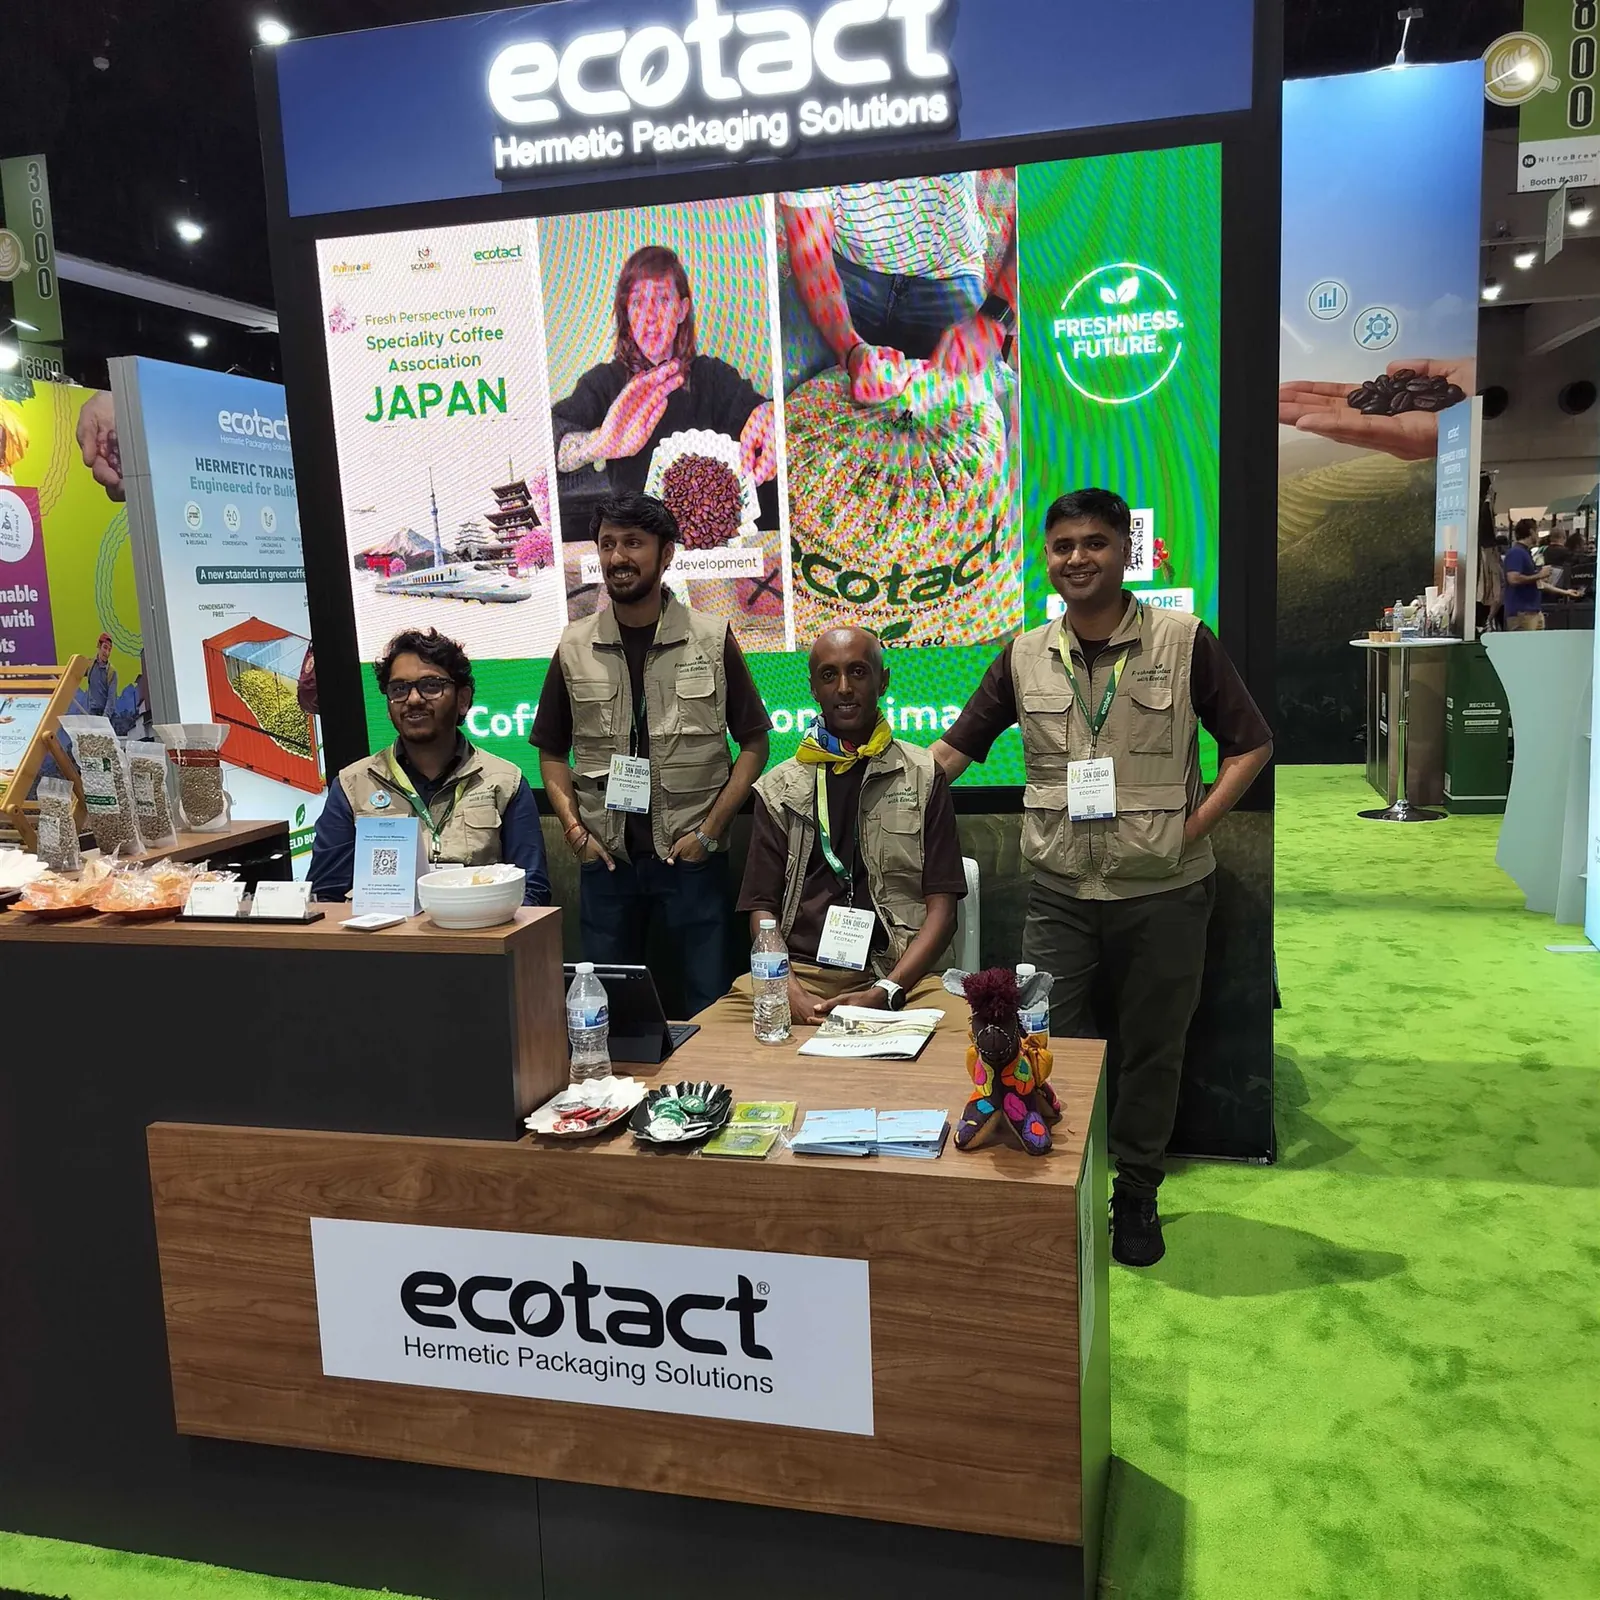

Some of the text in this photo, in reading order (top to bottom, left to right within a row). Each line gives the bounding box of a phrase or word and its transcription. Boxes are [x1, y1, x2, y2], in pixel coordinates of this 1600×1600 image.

[488, 0, 950, 123] ecotact
[494, 91, 948, 168] Hermetic Packaging Solutions
[1530, 177, 1556, 186] Booth
[1568, 174, 1588, 183] 3817
[27, 161, 53, 299] 3600
[474, 245, 522, 260] ecotact
[365, 306, 496, 326] Fresh Perspective from
[1053, 310, 1184, 338] FRESHNESS.
[366, 328, 504, 352] Speciality Coffee
[1073, 334, 1163, 359] FUTURE.
[388, 354, 482, 372] Association
[365, 377, 507, 422] JAPAN
[218, 408, 291, 440] ecotact
[220, 435, 244, 446] Hermetic
[246, 438, 271, 451] Packaging
[195, 457, 256, 476] HERMETIC
[190, 476, 296, 498] Engineered for Bulk
[675, 558, 757, 571] development
[791, 514, 1002, 605] cotact
[200, 569, 207, 580] A
[208, 571, 225, 580] new
[225, 569, 259, 580] standard
[260, 569, 268, 578] in
[268, 570, 288, 581] green
[814, 598, 850, 614] GREEN
[855, 608, 897, 617] COFFEE
[901, 601, 950, 616] EXPORTS
[955, 586, 978, 601] ONLY
[1, 609, 35, 628] with
[921, 636, 944, 647] 80
[625, 766, 633, 774] SAN
[635, 768, 649, 776] DIEGO
[1093, 769, 1109, 778] DIEGO
[842, 918, 851, 926] SAN
[853, 920, 870, 929] DIEGO
[404, 1336, 773, 1394] Hermetic Packaging Solutions
